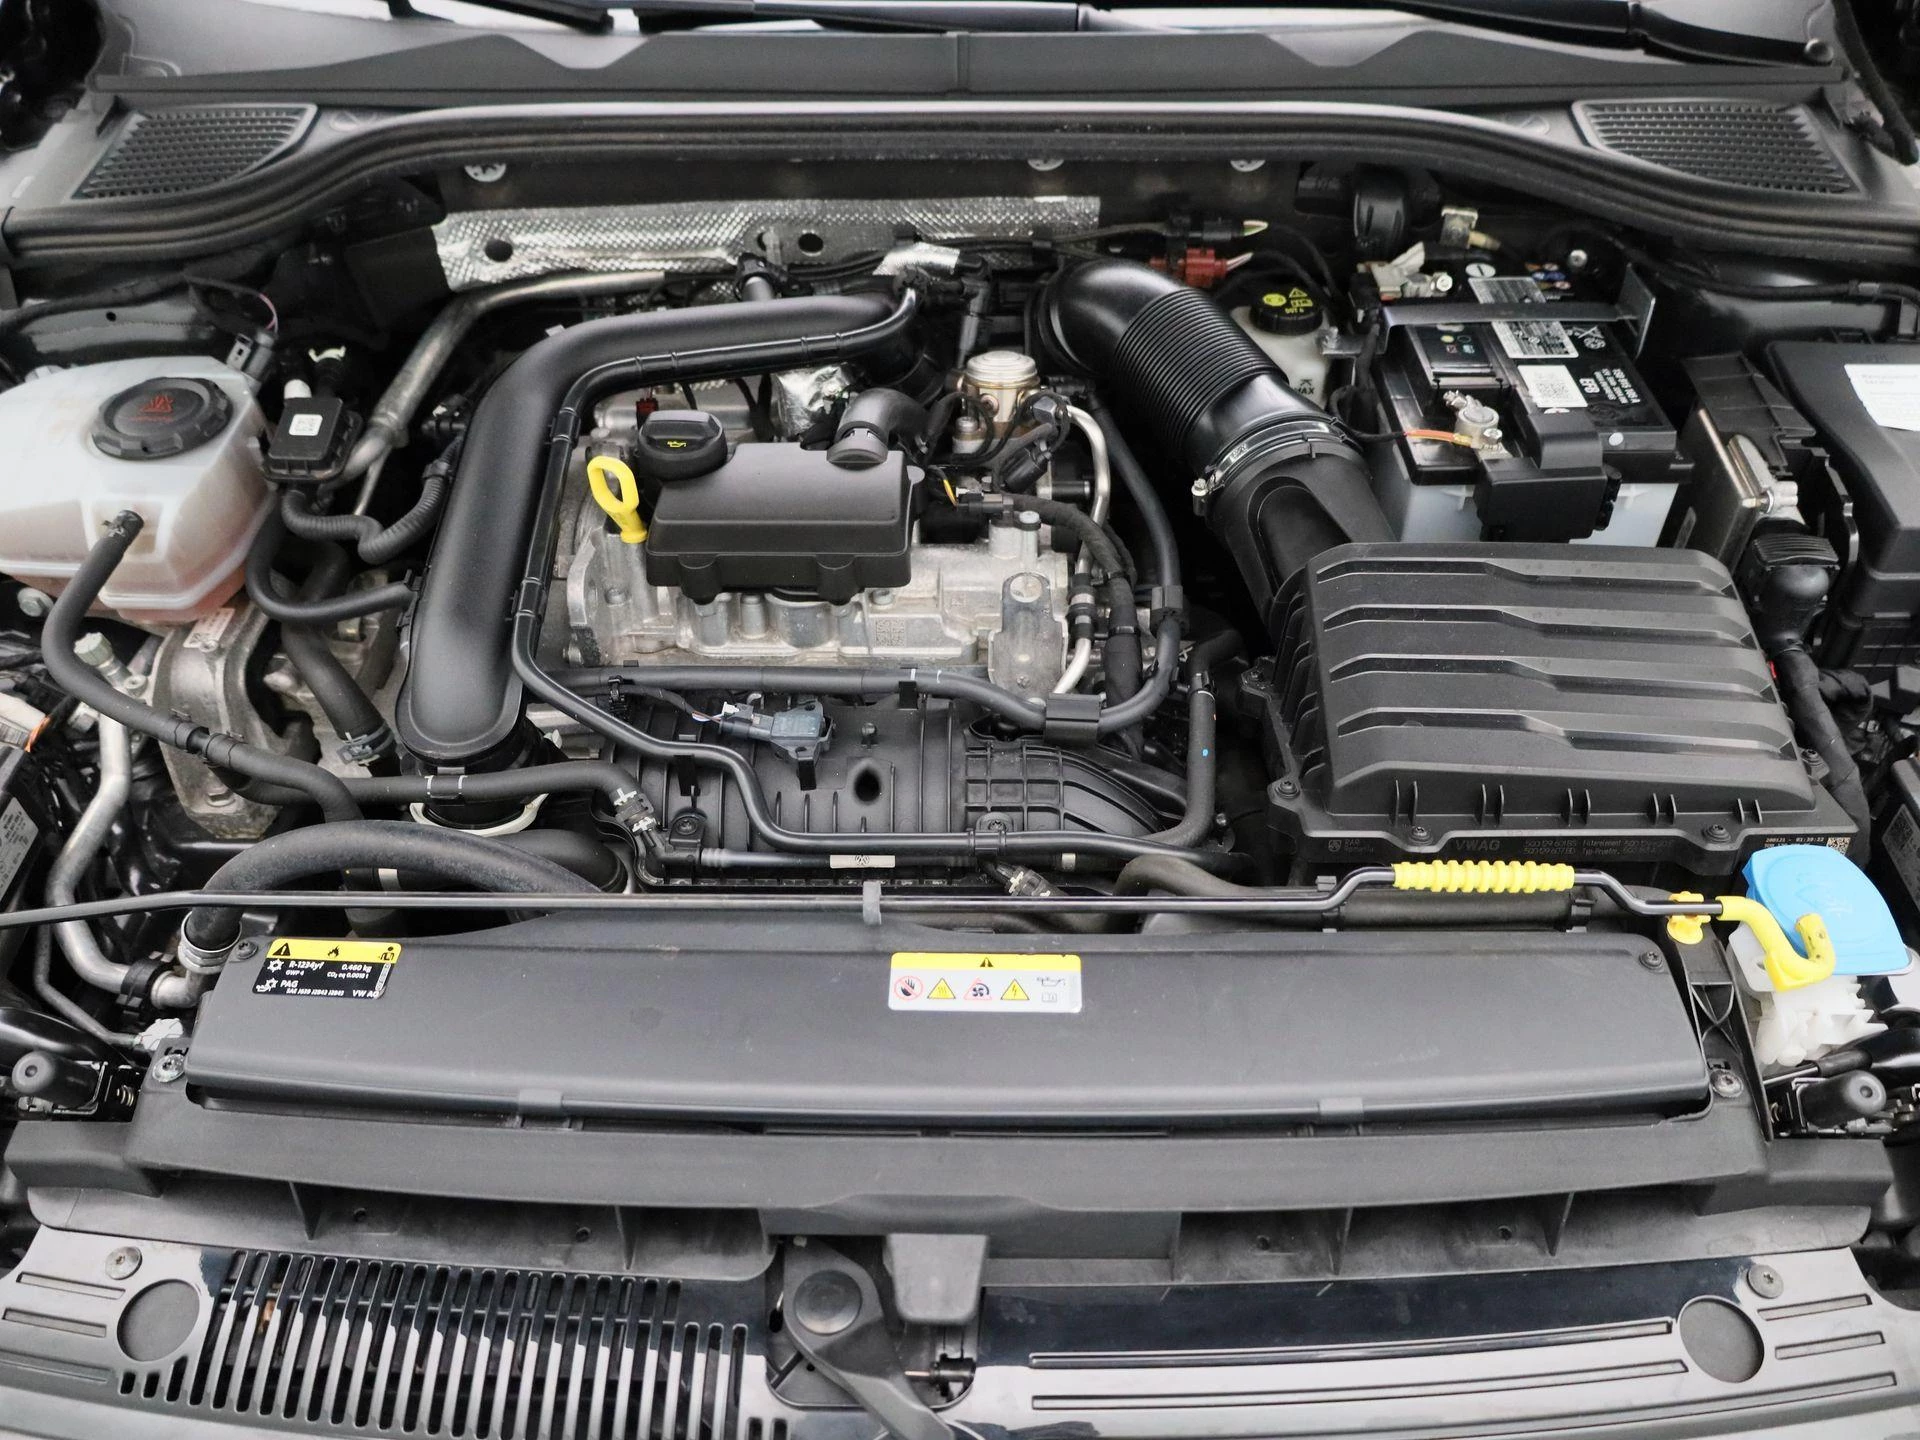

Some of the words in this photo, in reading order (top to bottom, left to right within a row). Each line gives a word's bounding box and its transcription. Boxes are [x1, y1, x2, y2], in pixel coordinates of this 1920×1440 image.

[1579, 378, 1600, 393] EFB
[1455, 840, 1500, 851] VWAG
[289, 961, 324, 971] R-1234yf
[362, 964, 372, 972] kg
[280, 980, 298, 988] PAG
